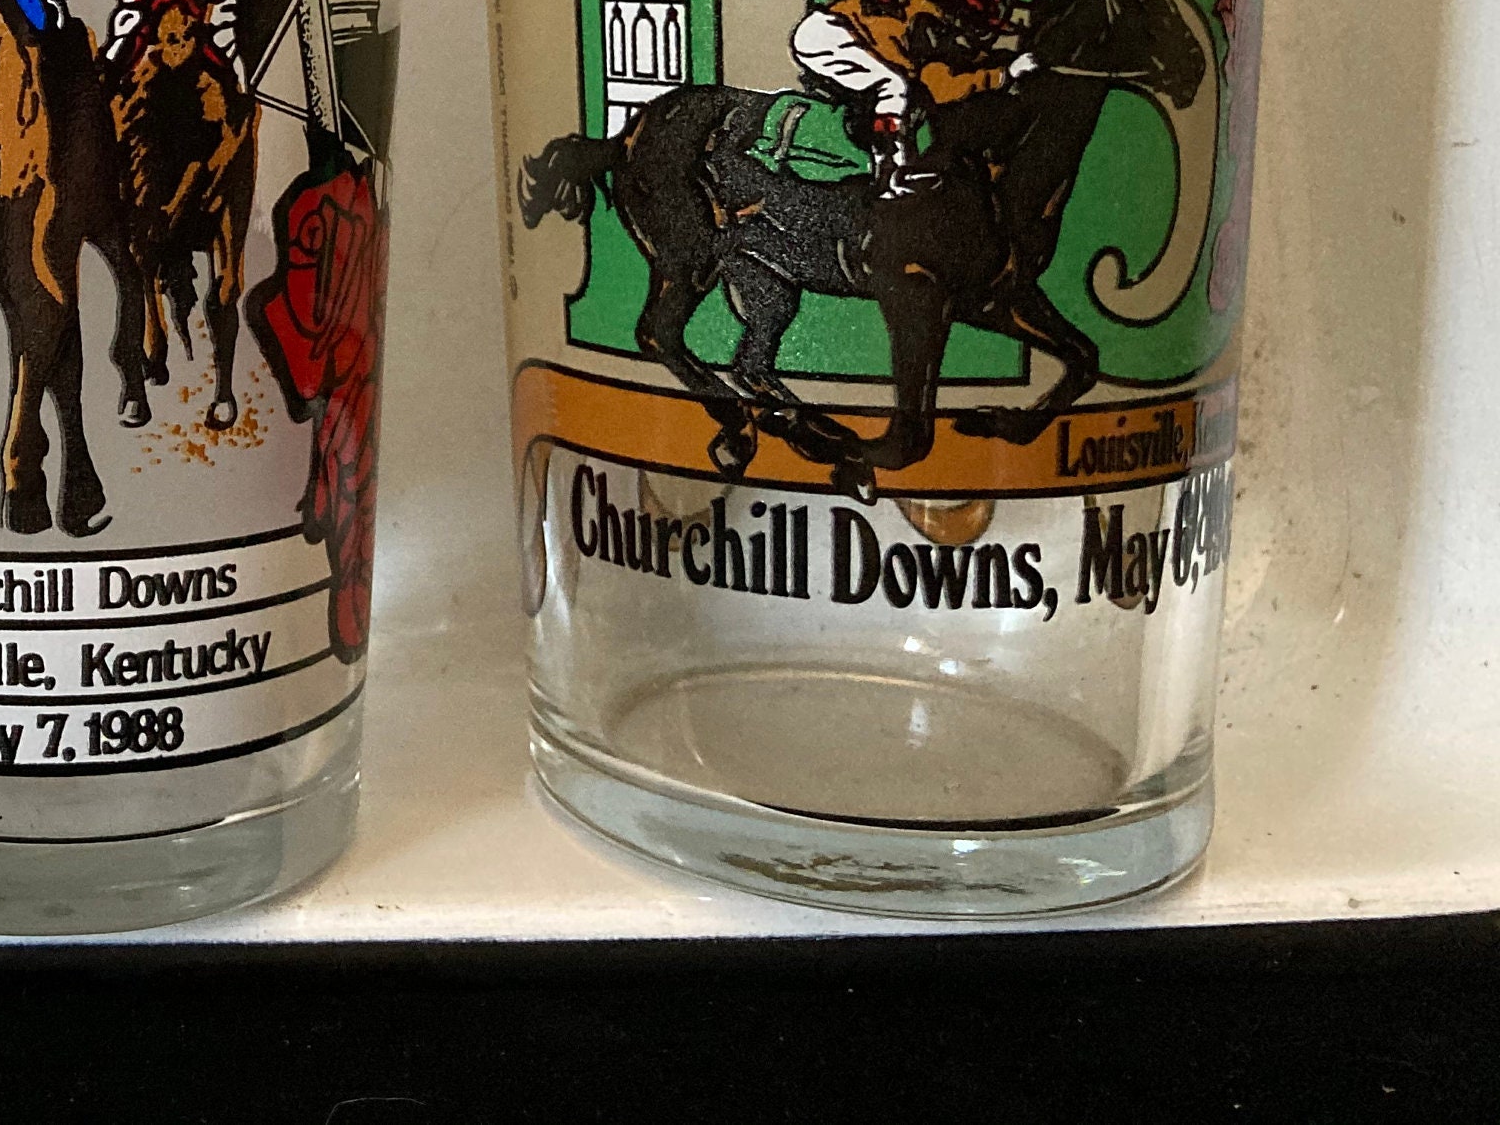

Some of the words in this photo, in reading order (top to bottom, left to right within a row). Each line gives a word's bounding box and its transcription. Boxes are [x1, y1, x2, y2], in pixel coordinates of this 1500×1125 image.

[1055, 407, 1189, 478] Louisville,
[571, 463, 812, 601] Churchill
[829, 505, 1059, 623] Downs,
[1075, 504, 1174, 615] May
[98, 559, 238, 611] Downs
[80, 629, 272, 688] Kentucky
[83, 706, 185, 756] 1988
